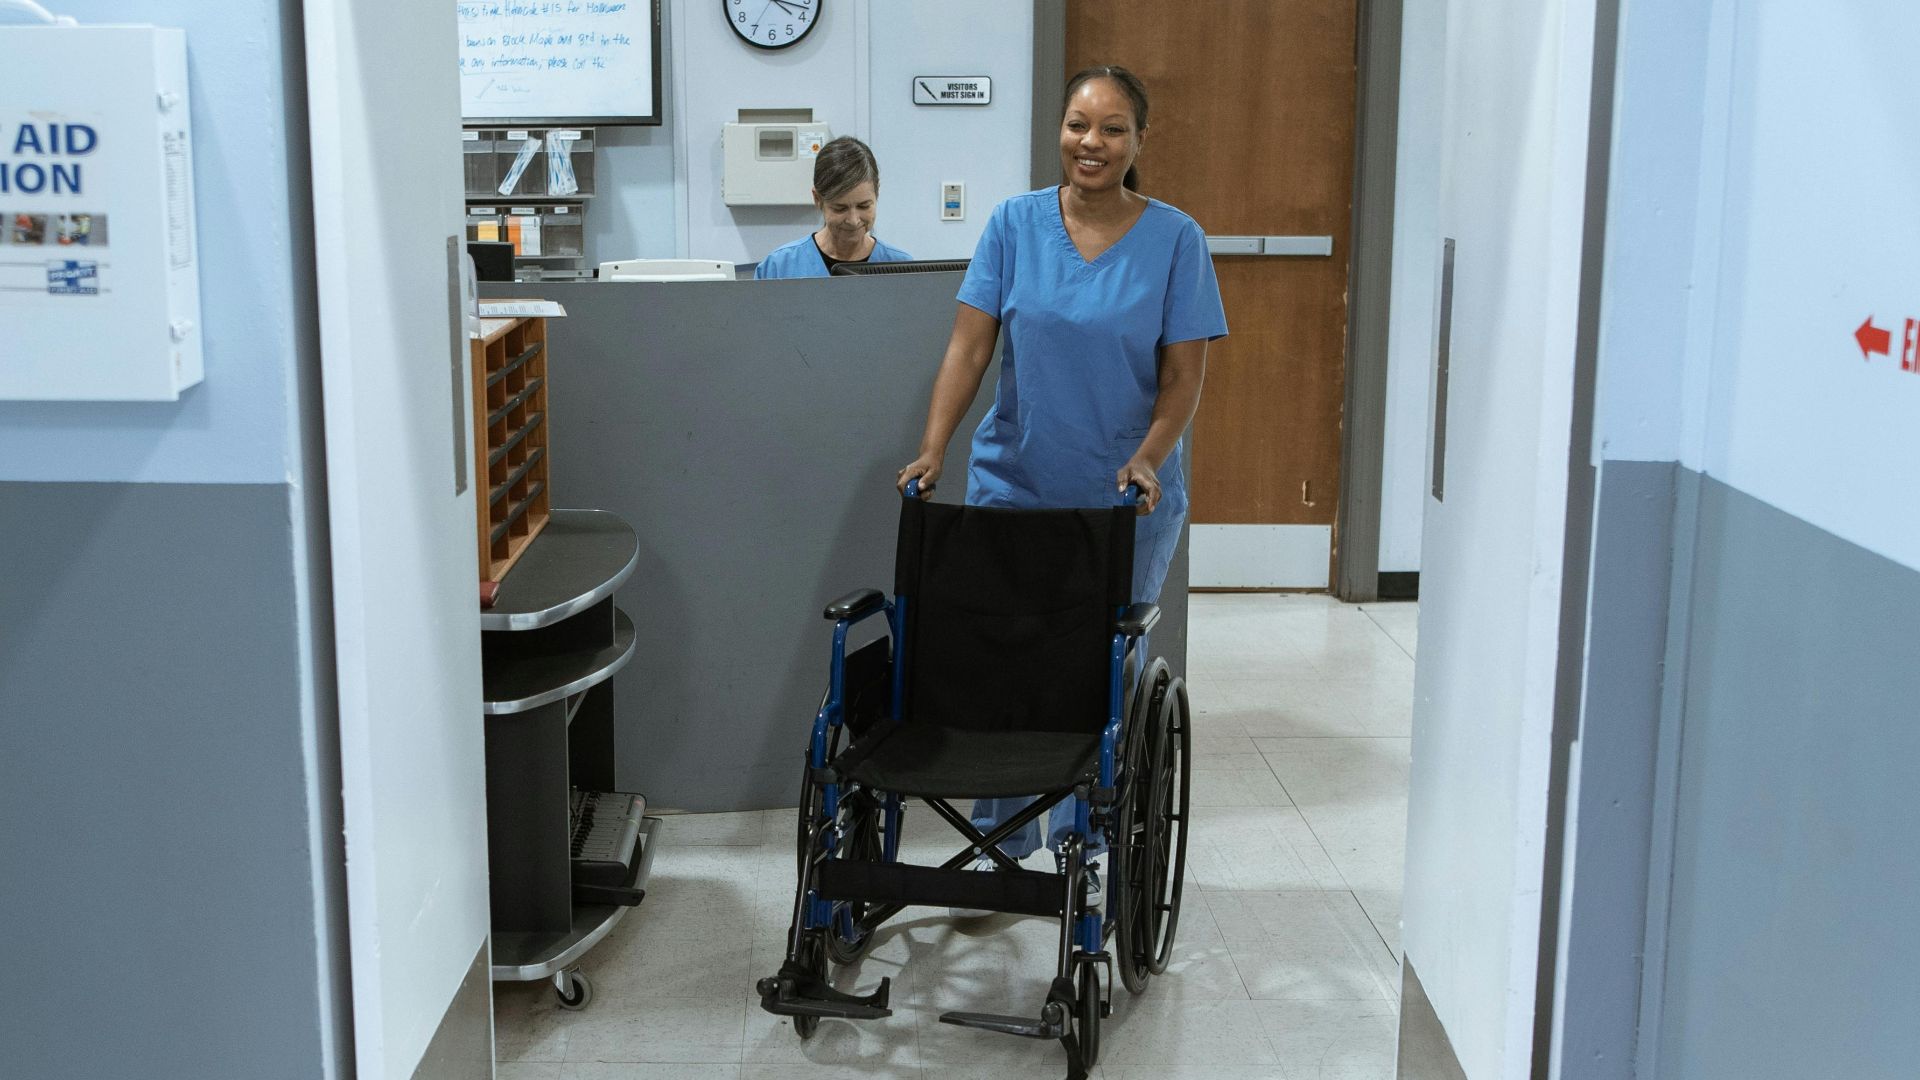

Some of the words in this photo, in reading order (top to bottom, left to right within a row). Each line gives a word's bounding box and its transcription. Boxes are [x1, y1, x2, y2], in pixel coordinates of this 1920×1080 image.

[738, 11, 746, 23] 8
[798, 11, 806, 23] 4
[750, 24, 759, 36] 7
[768, 29, 777, 41] 6
[785, 24, 794, 36] 5
[612, 33, 630, 45] the
[947, 83, 978, 91] VISITORS
[940, 91, 959, 99] MUST
[960, 91, 976, 99] SIGN
[977, 91, 984, 99] IN
[14, 123, 98, 156] AID
